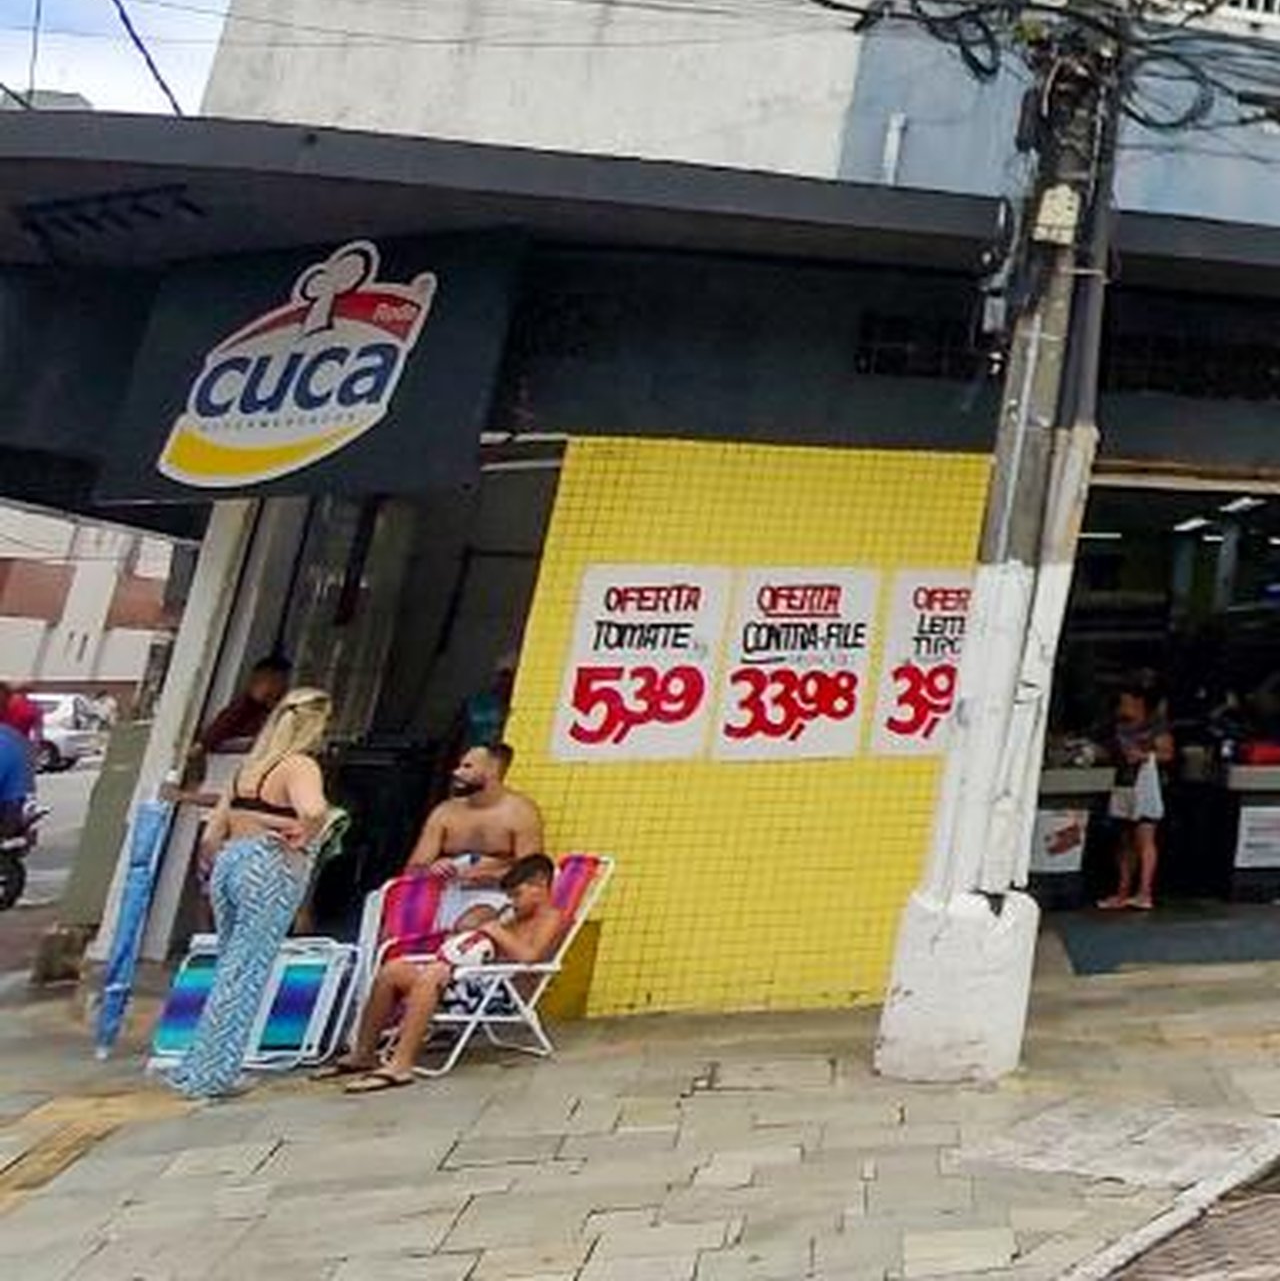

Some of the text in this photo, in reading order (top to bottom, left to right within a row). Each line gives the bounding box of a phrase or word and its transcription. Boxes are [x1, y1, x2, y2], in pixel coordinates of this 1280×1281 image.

[195, 343, 399, 417] cuca
[604, 585, 701, 613] OFERTA
[757, 584, 842, 613] OFERTA
[913, 585, 972, 612] OFER
[593, 619, 694, 651] TOMATE
[917, 613, 966, 635] LEIT
[724, 667, 858, 742] 33,98
[886, 661, 959, 740] 3,9
